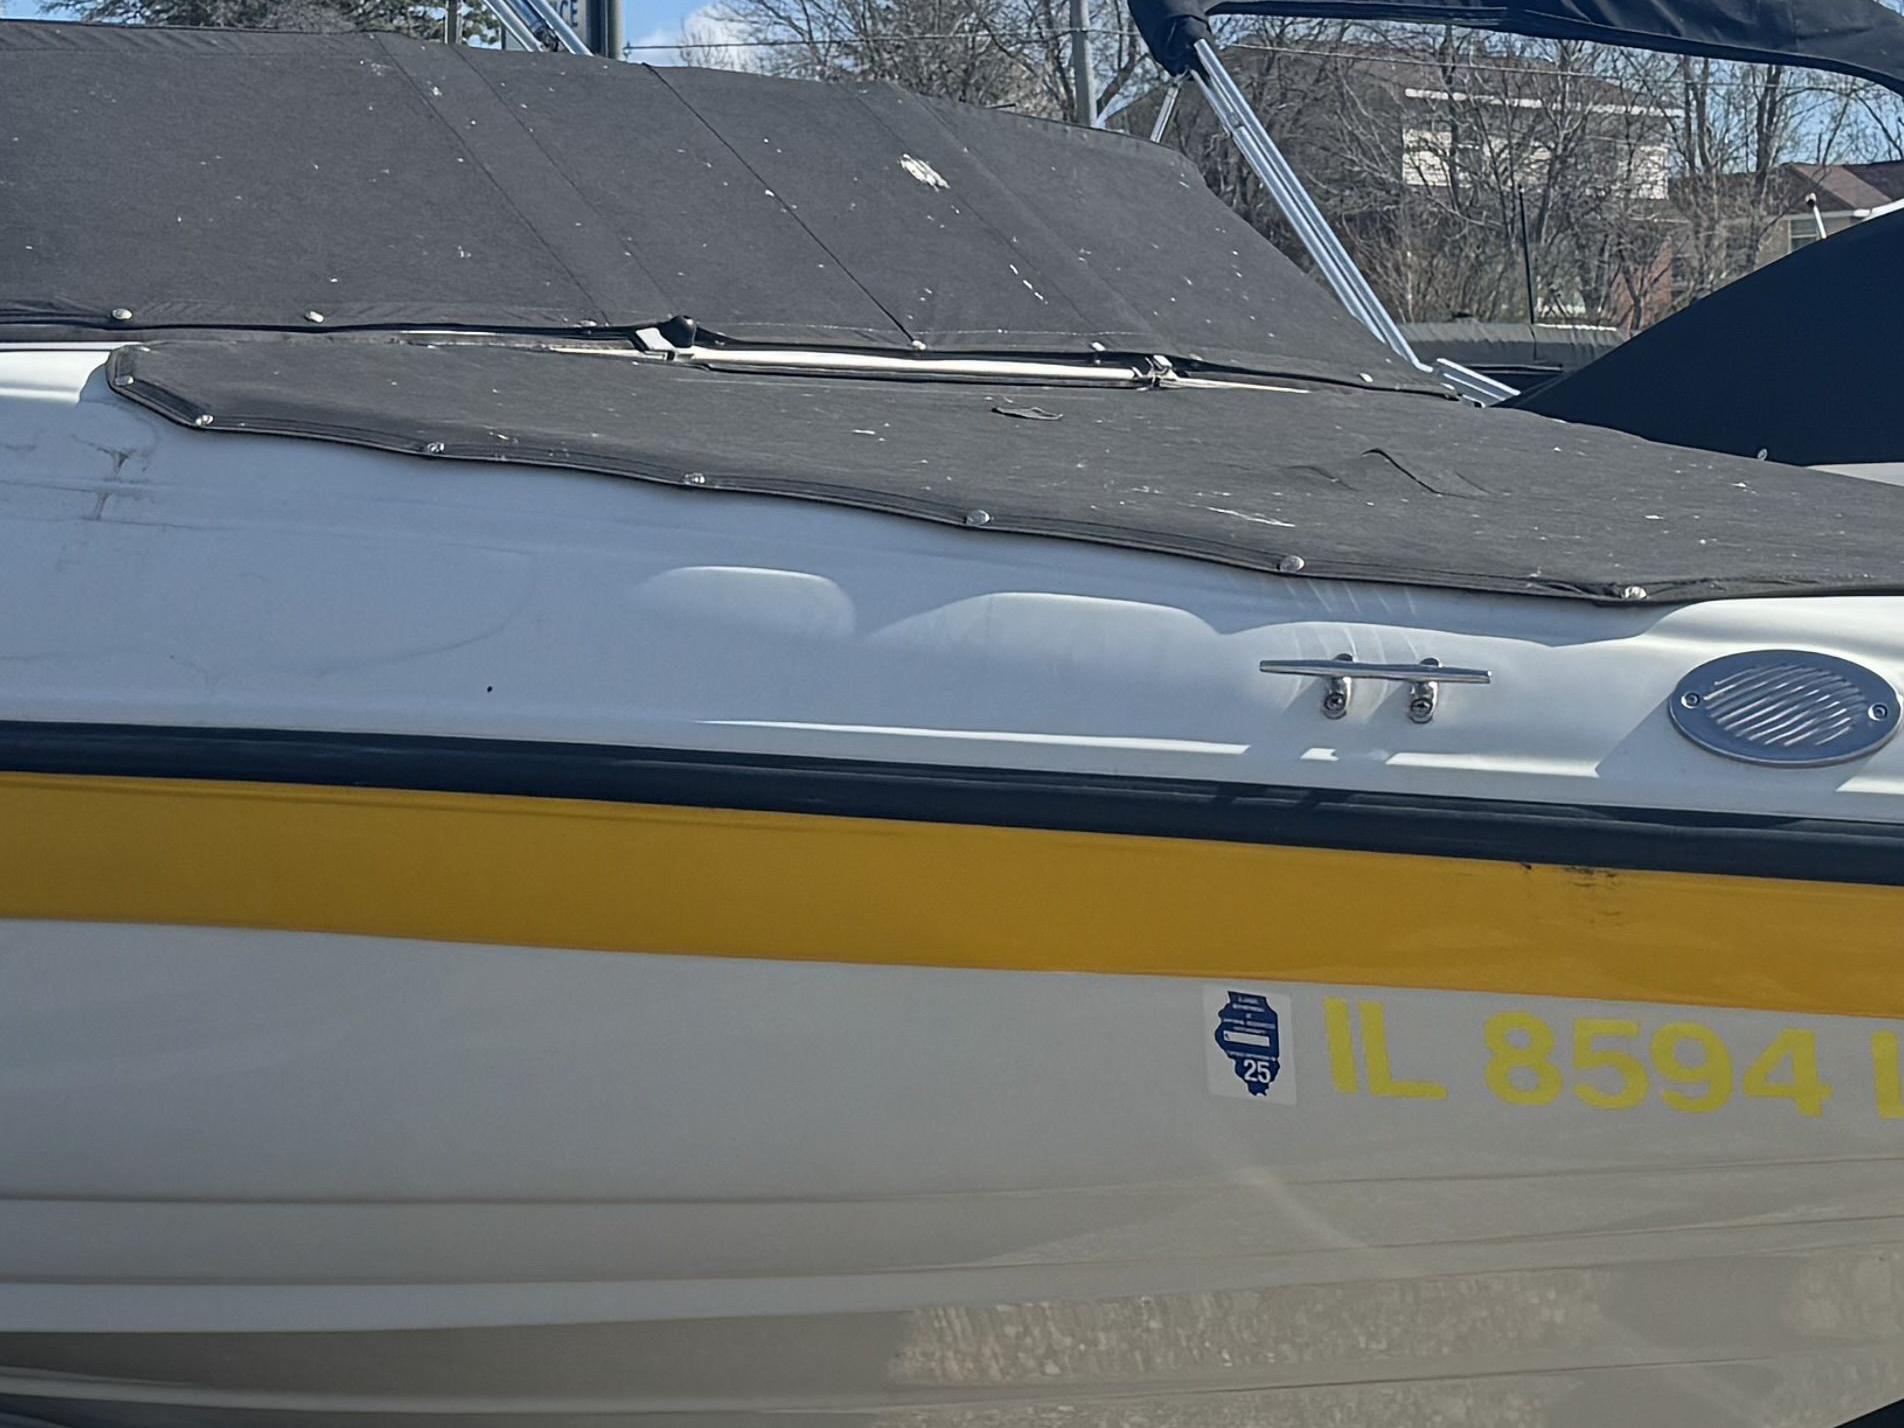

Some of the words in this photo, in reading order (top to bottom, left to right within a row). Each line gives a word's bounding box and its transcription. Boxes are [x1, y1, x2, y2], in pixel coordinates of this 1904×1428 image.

[1243, 1059, 1272, 1084] 25
[1324, 998, 1447, 1099] IL
[1484, 1011, 1832, 1117] 8594
